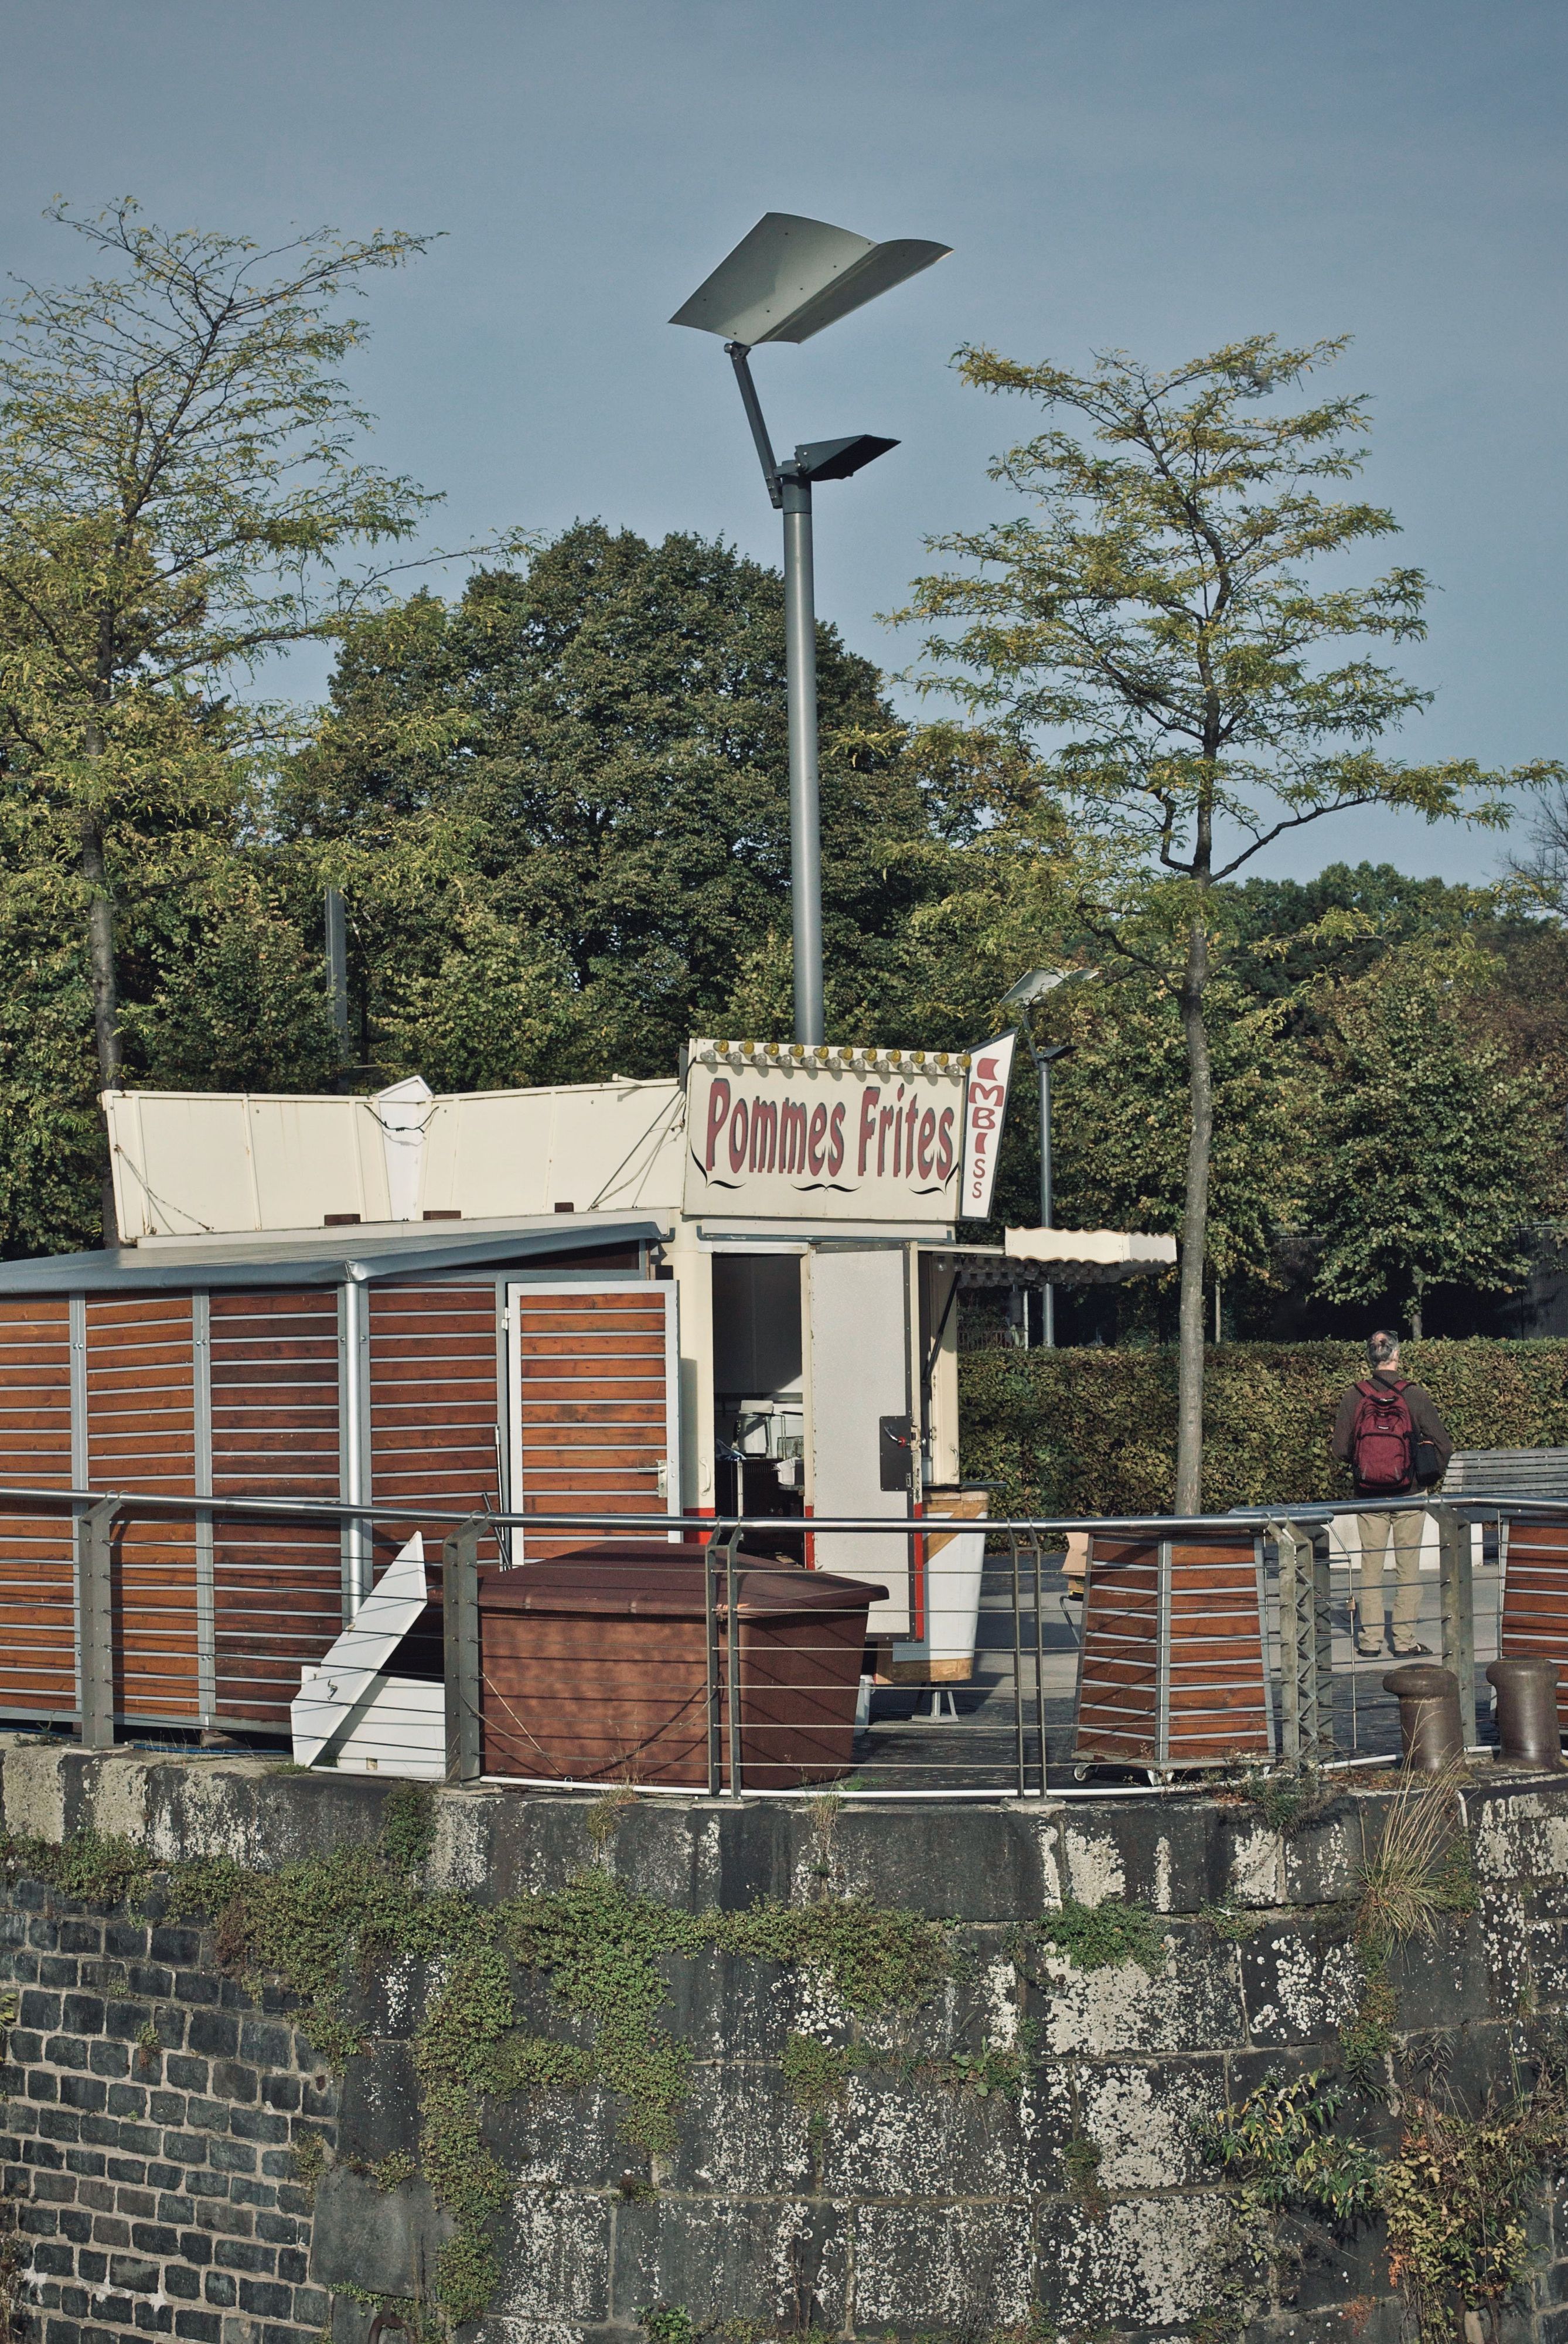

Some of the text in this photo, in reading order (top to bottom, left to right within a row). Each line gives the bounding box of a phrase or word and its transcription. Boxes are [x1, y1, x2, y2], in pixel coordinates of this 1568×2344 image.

[705, 1078, 955, 1180] Pommes Frites
[969, 1057, 1005, 1199] IMBISS
